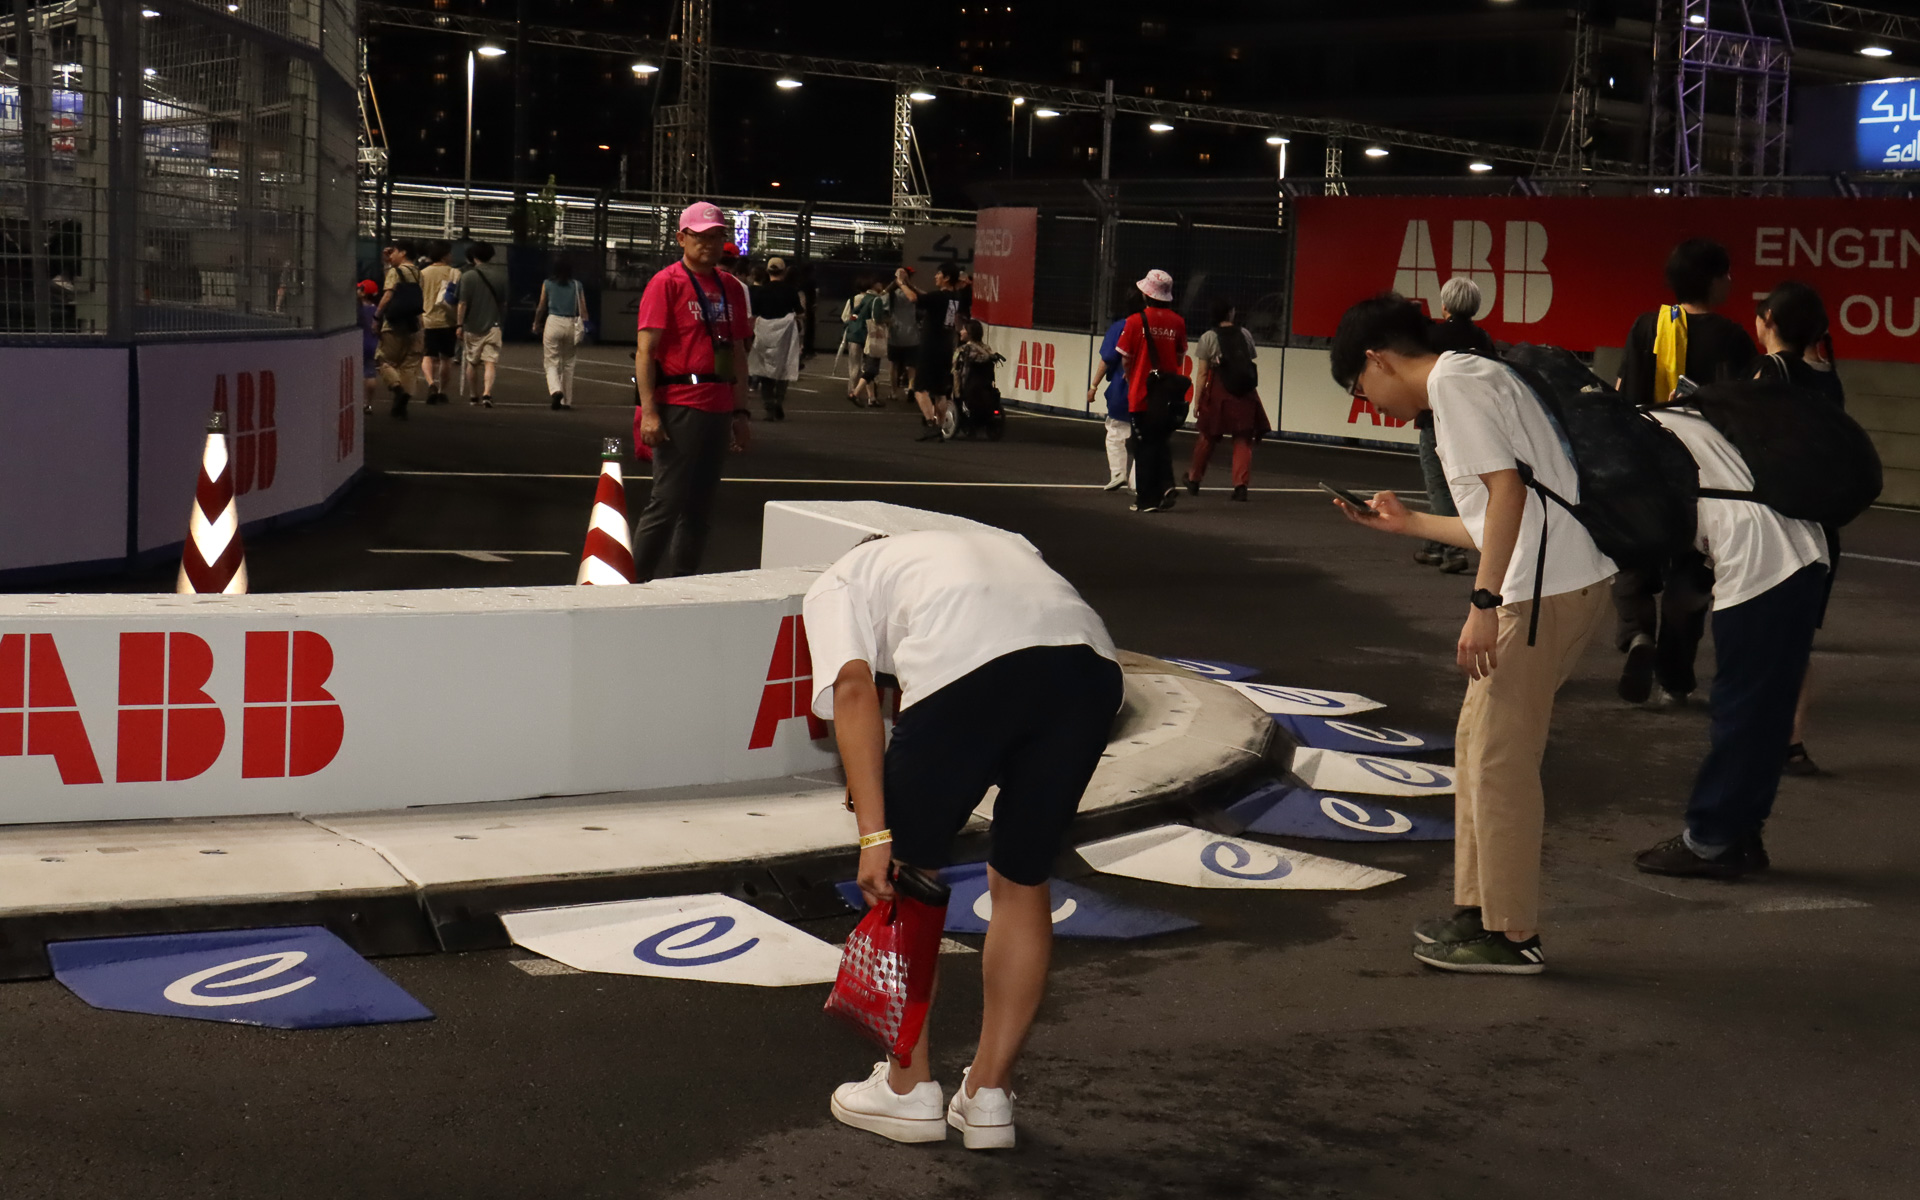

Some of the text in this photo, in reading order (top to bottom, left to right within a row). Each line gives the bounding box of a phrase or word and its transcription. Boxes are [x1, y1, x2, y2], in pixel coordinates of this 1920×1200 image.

[1390, 219, 1554, 324] ABB
[1014, 340, 1056, 393] ABB
[0, 630, 345, 785] ABB
